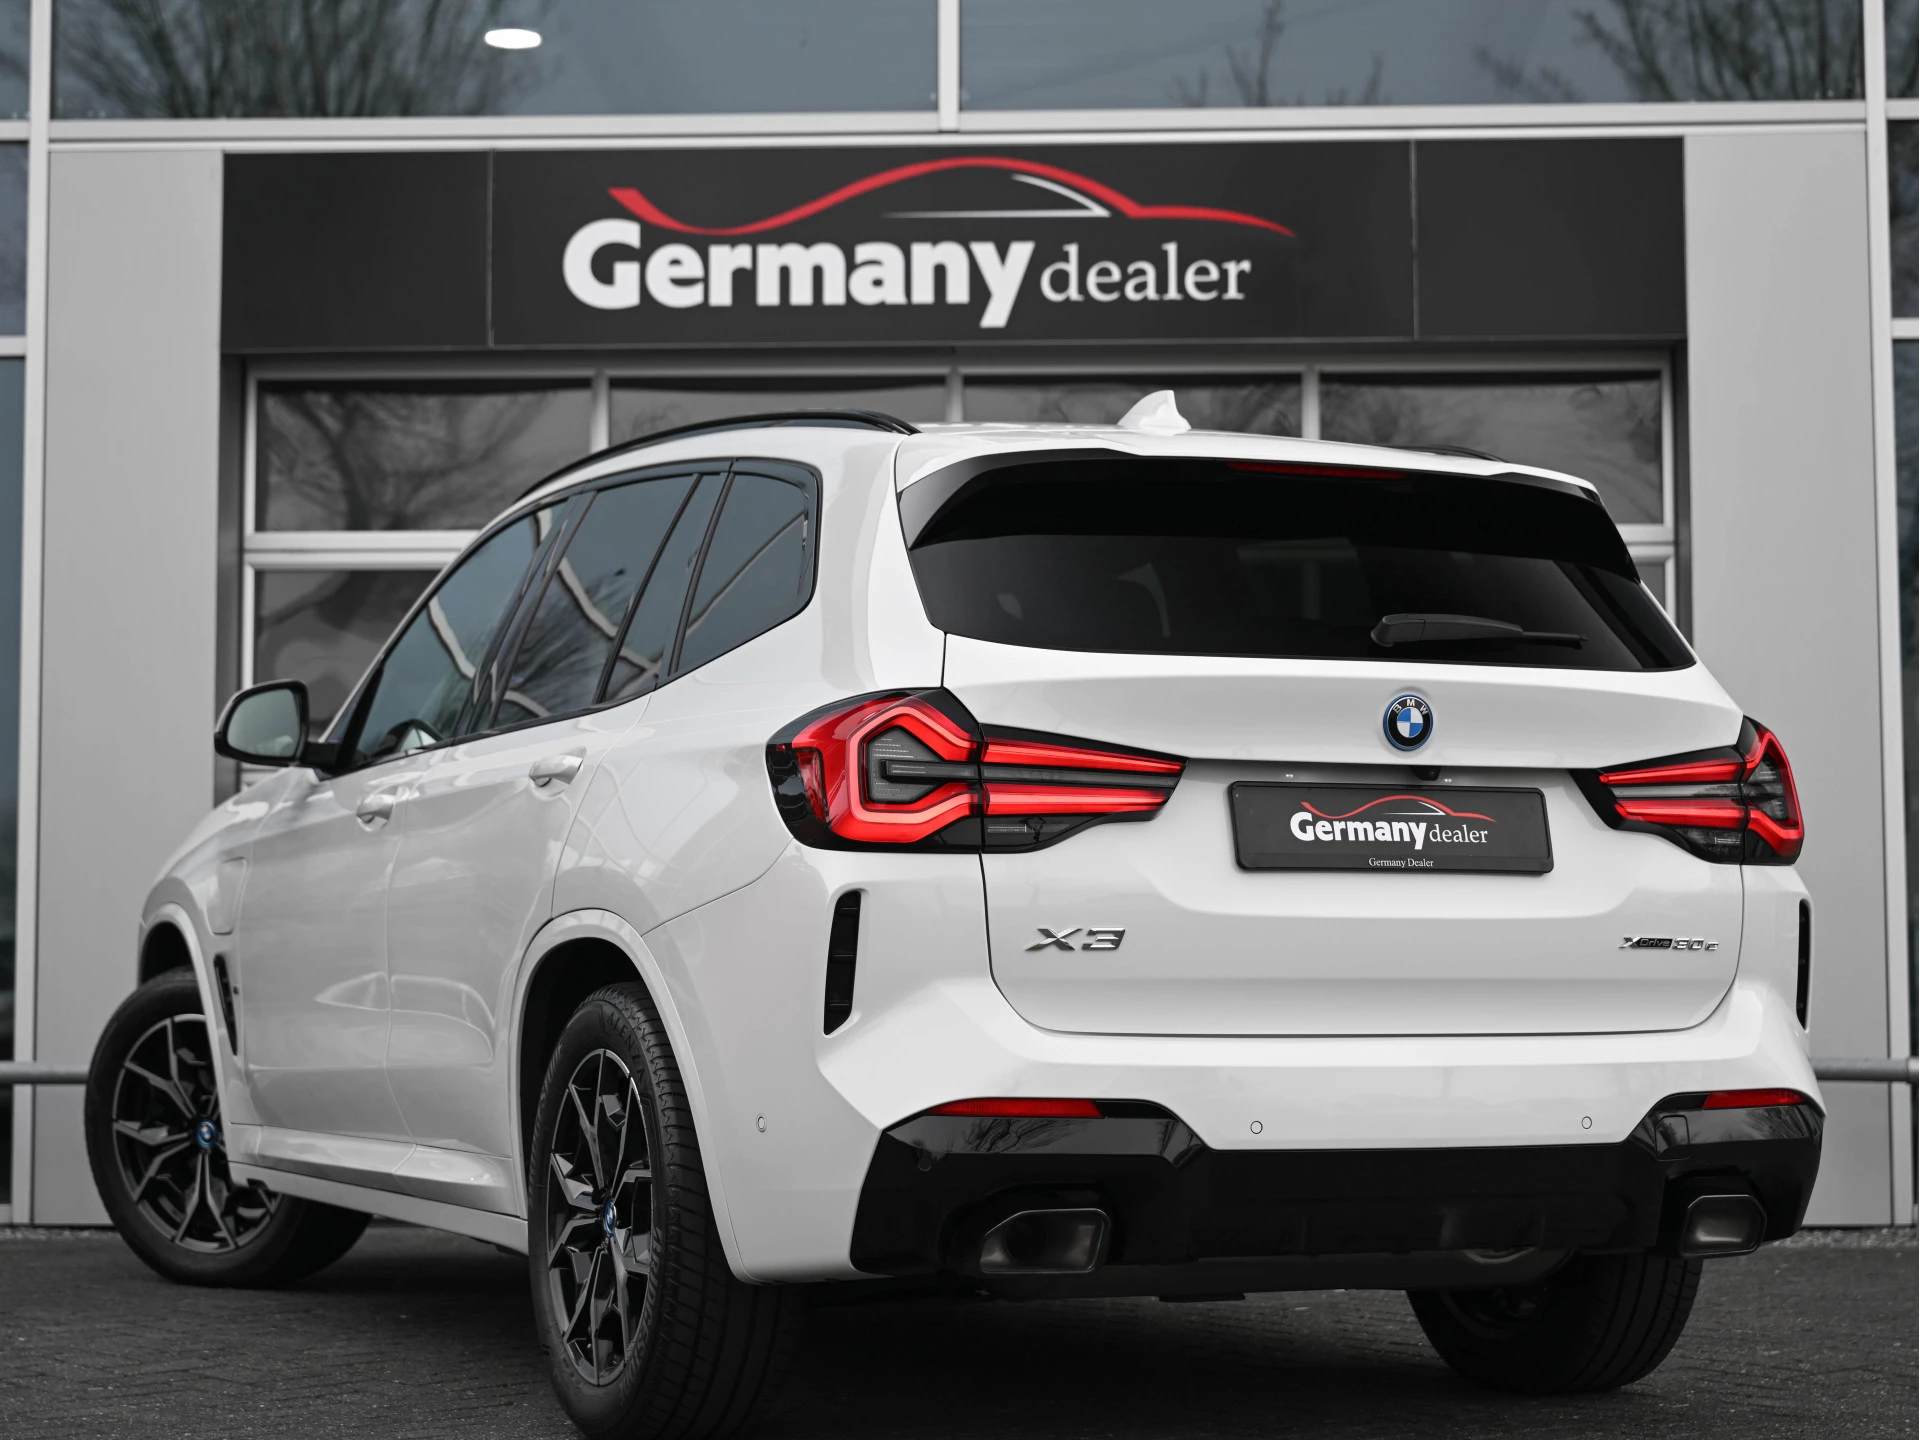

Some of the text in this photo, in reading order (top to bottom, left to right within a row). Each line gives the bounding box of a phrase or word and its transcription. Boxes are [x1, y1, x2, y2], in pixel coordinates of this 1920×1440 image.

[563, 218, 1252, 328] Germany dealer
[1393, 698, 1428, 716] BMW
[1290, 811, 1488, 850] Germany dealer
[1368, 857, 1434, 868] Germany Dealer
[1024, 927, 1126, 952] X3
[606, 1011, 646, 1083] ALENZA
